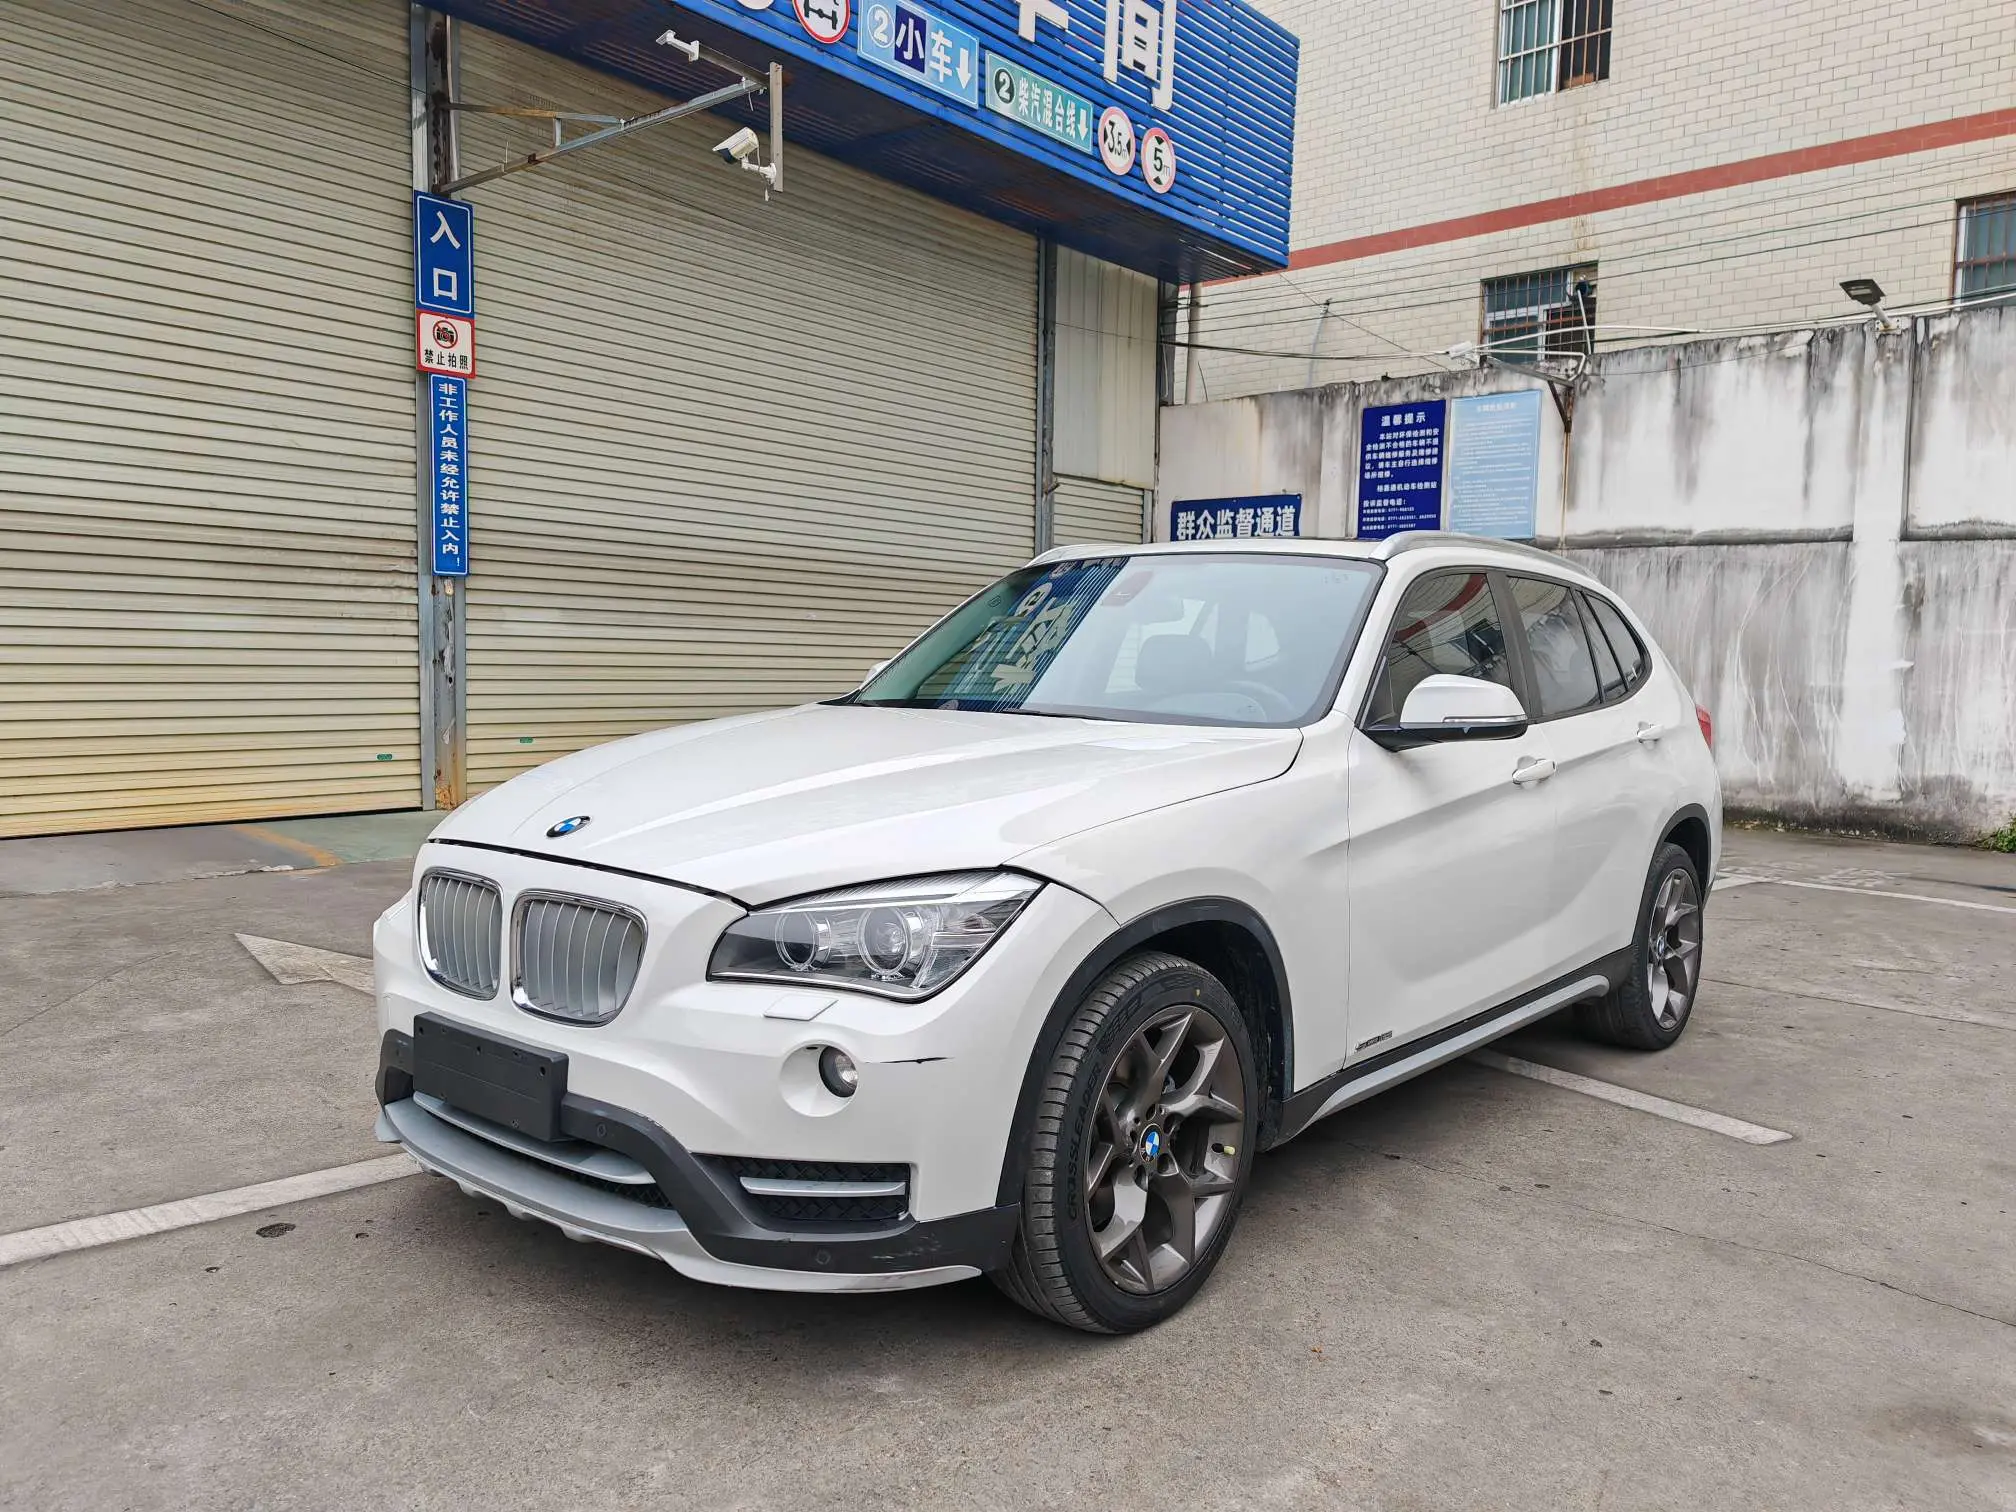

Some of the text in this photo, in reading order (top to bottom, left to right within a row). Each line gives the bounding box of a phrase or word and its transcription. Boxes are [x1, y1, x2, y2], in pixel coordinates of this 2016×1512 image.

[430, 210, 461, 301] 入口
[424, 348, 469, 371] 禁止拍照
[1381, 411, 1426, 427] 温馨提示
[1176, 505, 1296, 541] 群众监督通道
